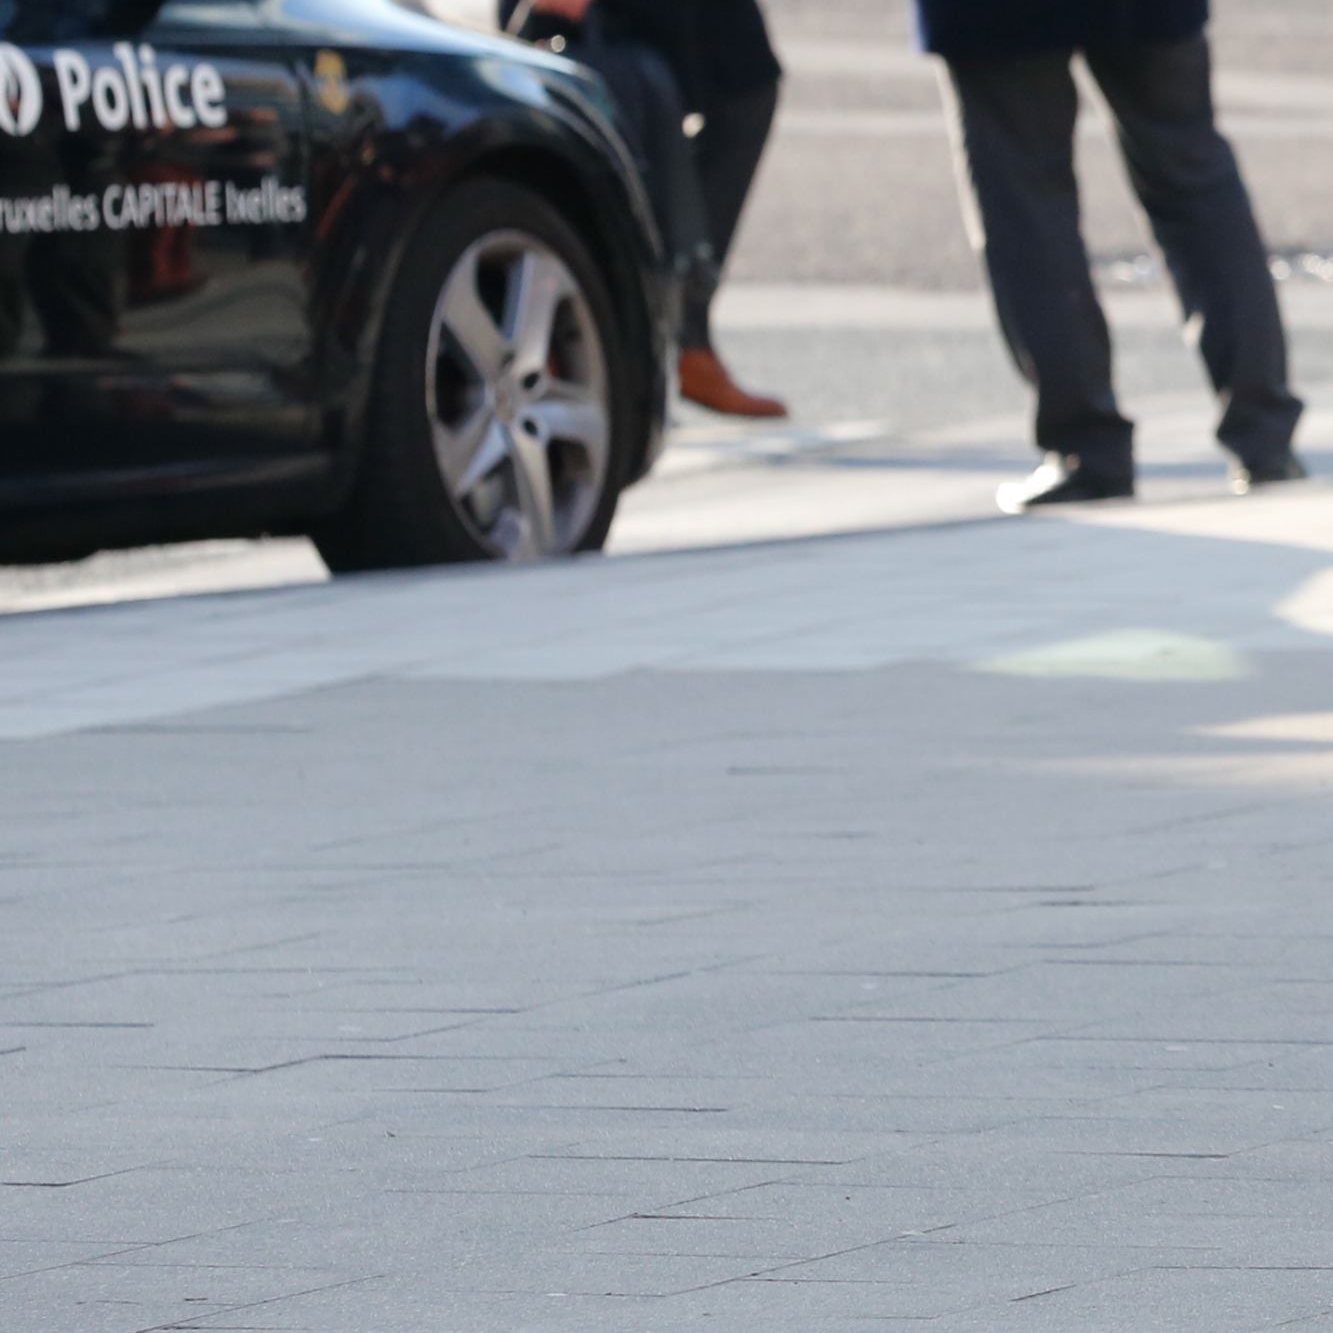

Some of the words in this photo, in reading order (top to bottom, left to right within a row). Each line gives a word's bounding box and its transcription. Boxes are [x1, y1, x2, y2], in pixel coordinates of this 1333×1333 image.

[53, 41, 228, 132] Police
[102, 180, 222, 229] CAPITALE
[225, 176, 307, 226] Ixelles
